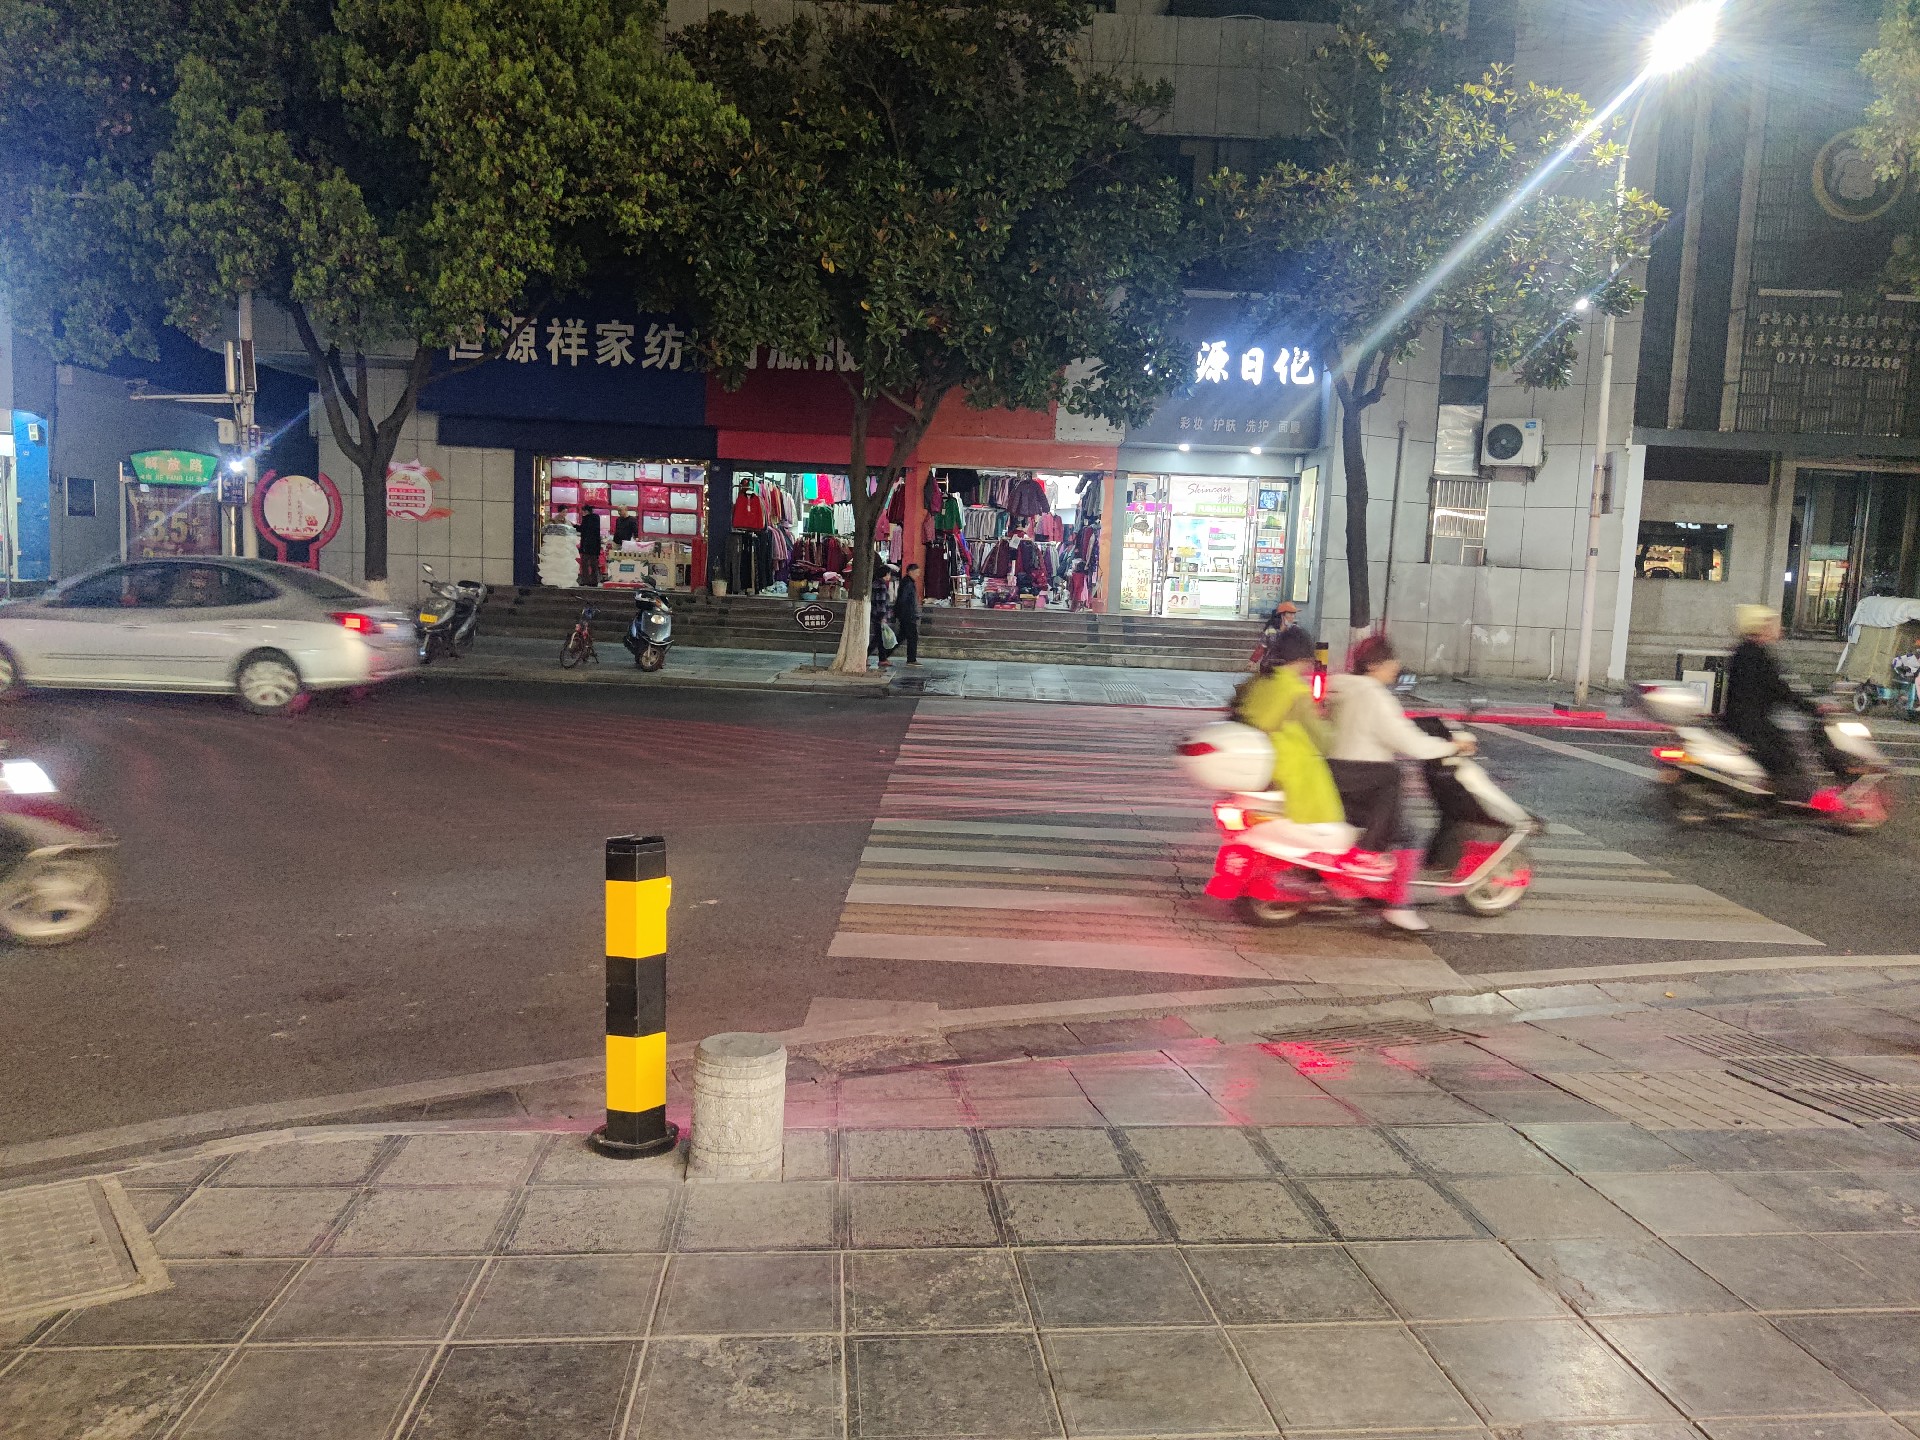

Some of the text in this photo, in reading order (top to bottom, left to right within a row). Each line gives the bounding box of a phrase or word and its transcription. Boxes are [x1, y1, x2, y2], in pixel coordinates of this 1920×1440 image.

[1143, 340, 1315, 385] 源日化
[1776, 351, 1901, 370] 0717-3822888
[1179, 416, 1203, 431] 彩妆
[1213, 418, 1236, 433] 护肤
[1245, 419, 1270, 433] 洗护
[144, 456, 203, 473] 解放路
